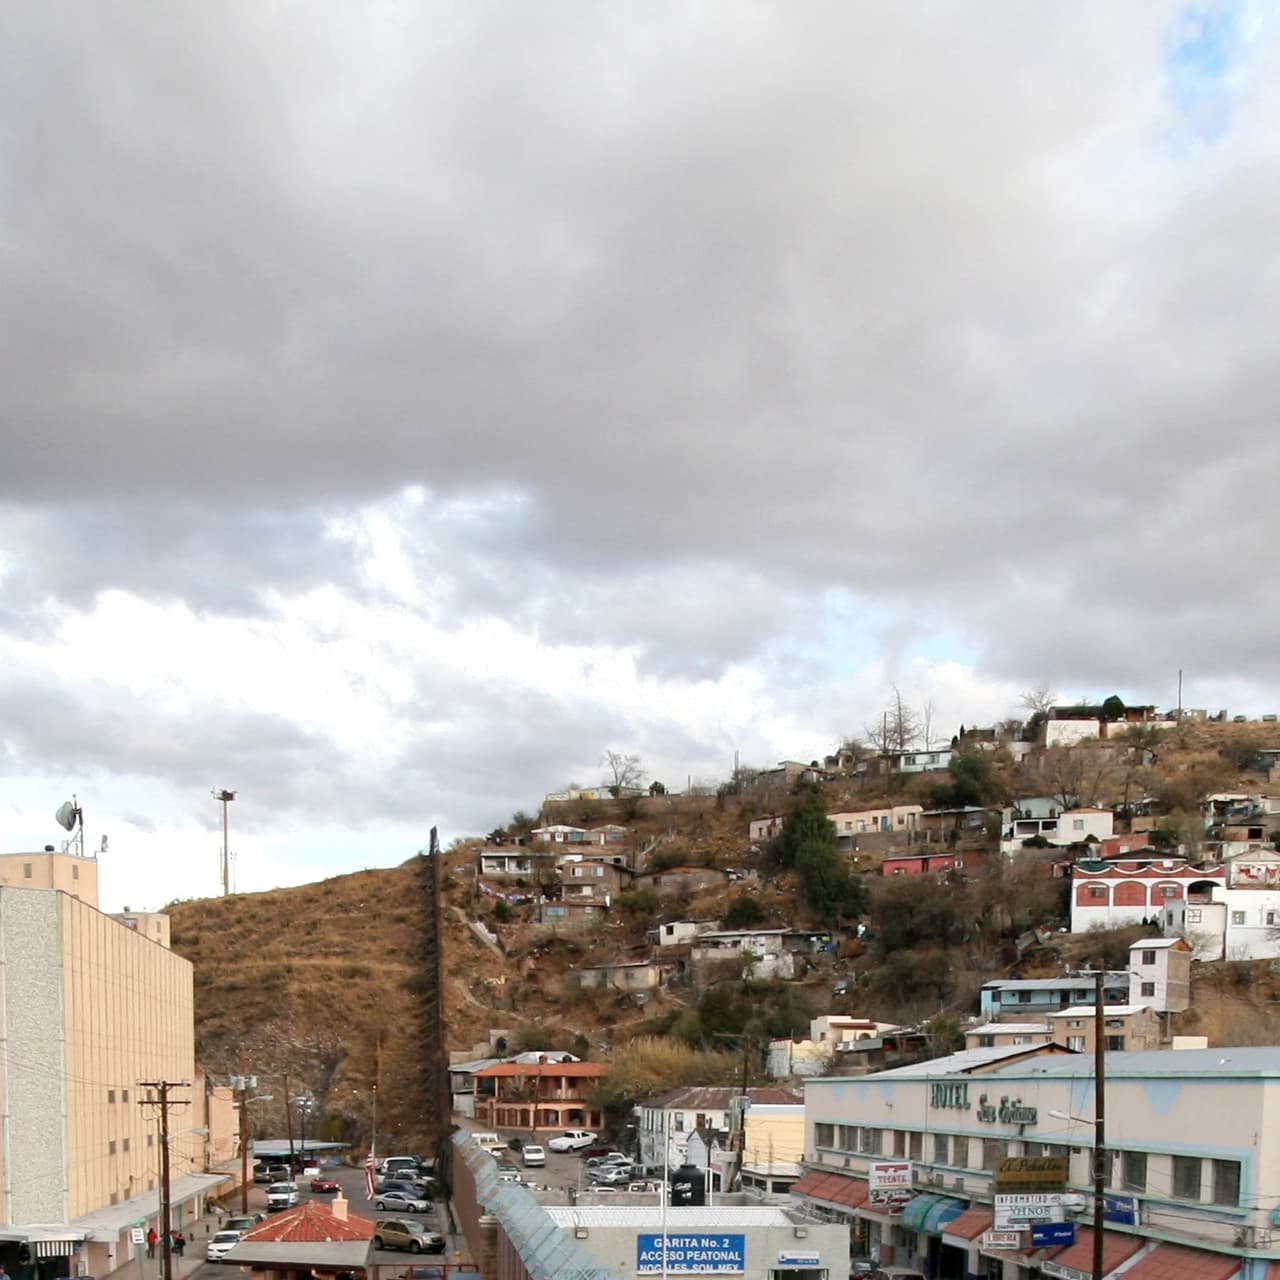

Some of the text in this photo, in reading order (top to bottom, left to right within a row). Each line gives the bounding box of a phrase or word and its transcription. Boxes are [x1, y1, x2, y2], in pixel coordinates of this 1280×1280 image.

[930, 1081, 971, 1110] HOTEL
[877, 1174, 907, 1184] TECATE
[654, 1238, 730, 1248] GARITA No. 2
[640, 1251, 742, 1261] ACCESO PEATONAL
